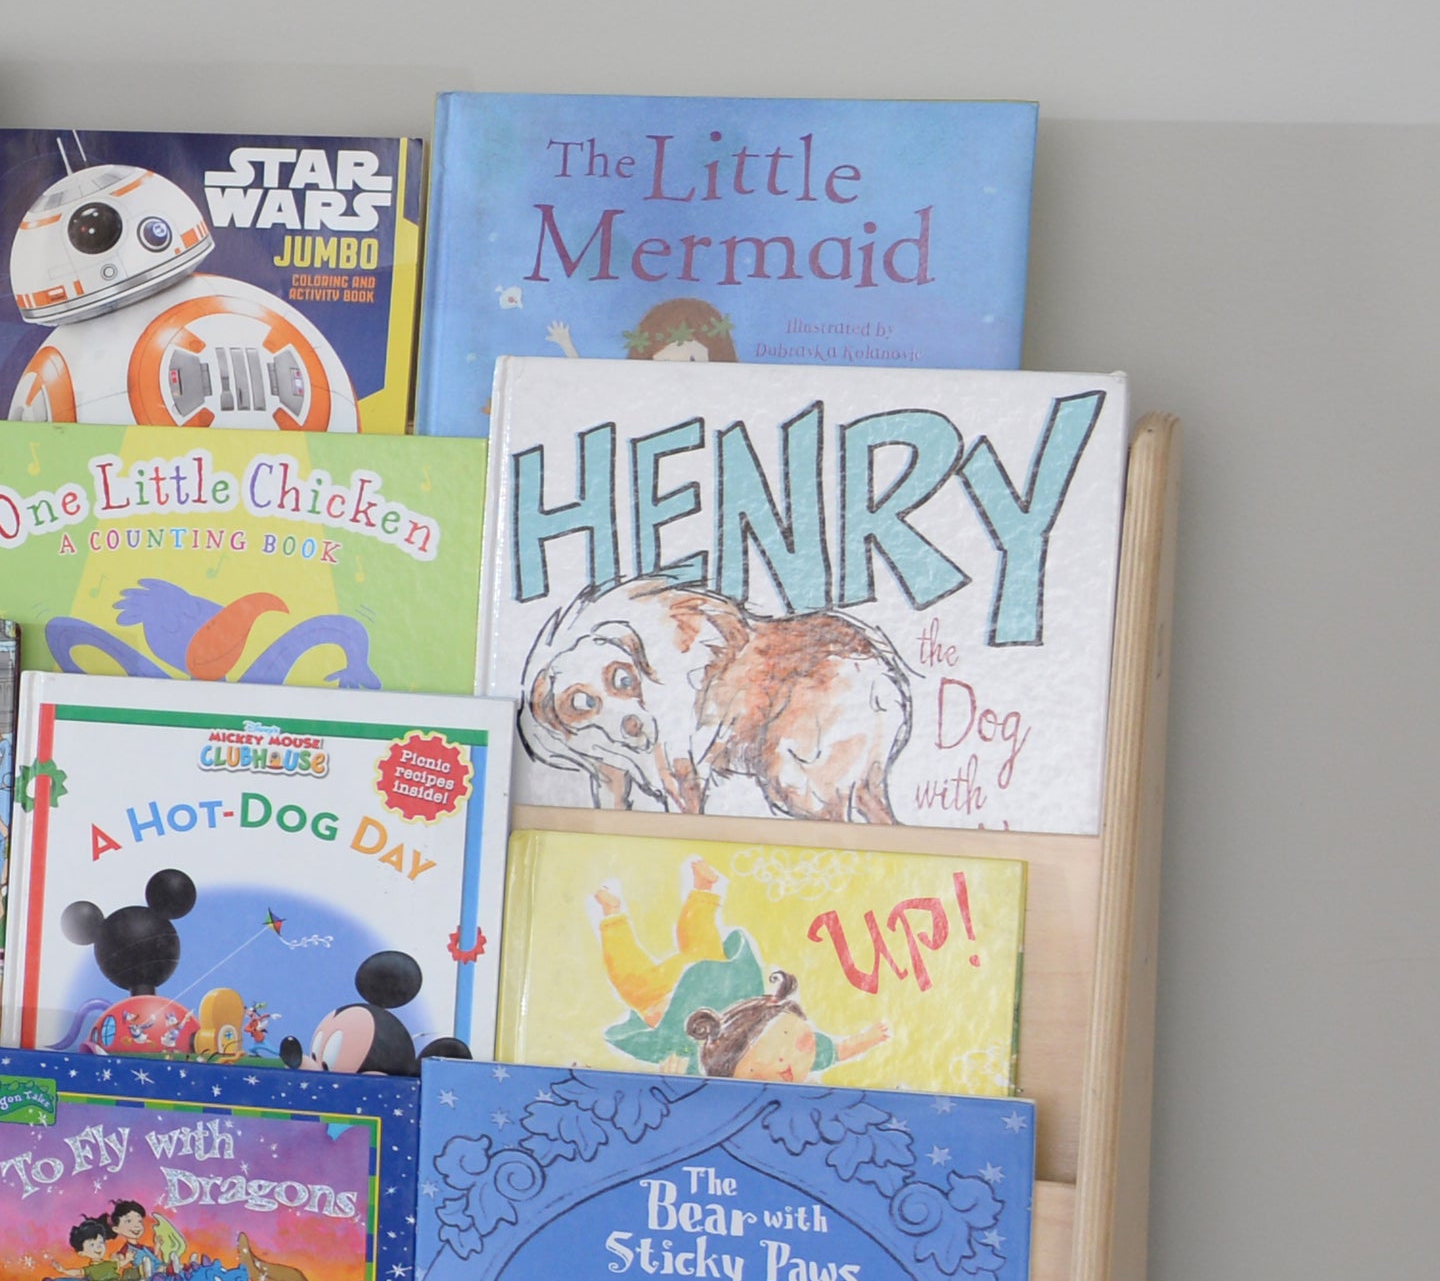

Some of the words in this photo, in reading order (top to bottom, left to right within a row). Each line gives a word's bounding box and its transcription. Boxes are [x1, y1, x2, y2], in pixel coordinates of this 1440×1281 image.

[204, 147, 393, 191] STAR
[547, 137, 636, 179] The
[643, 130, 862, 205] Little
[204, 187, 392, 232] WARS
[273, 235, 379, 270] JUMBO
[523, 203, 935, 288] Mermaid
[288, 288, 340, 302] ACTIVITY
[343, 289, 375, 303] BOOK
[291, 274, 349, 289] COLORING
[351, 275, 376, 289] AND
[785, 318, 871, 335] Illustrated
[875, 321, 894, 339] by
[95, 455, 231, 512] Little
[248, 461, 433, 553] Chicken
[511, 389, 1107, 647] HENRY
[59, 533, 77, 555] A
[89, 527, 247, 552] COUNTING
[261, 534, 342, 564] BOOK
[916, 617, 960, 667] the
[208, 731, 265, 746] MICKEY
[268, 736, 321, 750] MOUSE
[933, 677, 1032, 789] Dog
[394, 766, 455, 791] recipes
[399, 749, 451, 774] Picnic
[915, 753, 988, 815] with
[392, 779, 449, 805] inside!
[91, 823, 122, 862] A
[349, 815, 437, 883] DAY
[0, 1150, 65, 1200] To
[63, 1121, 131, 1175] Fly
[145, 1117, 236, 1163] with
[158, 1164, 358, 1219] Dragons
[681, 1165, 738, 1198] The
[640, 1177, 758, 1239] Bear
[763, 1205, 829, 1234] with
